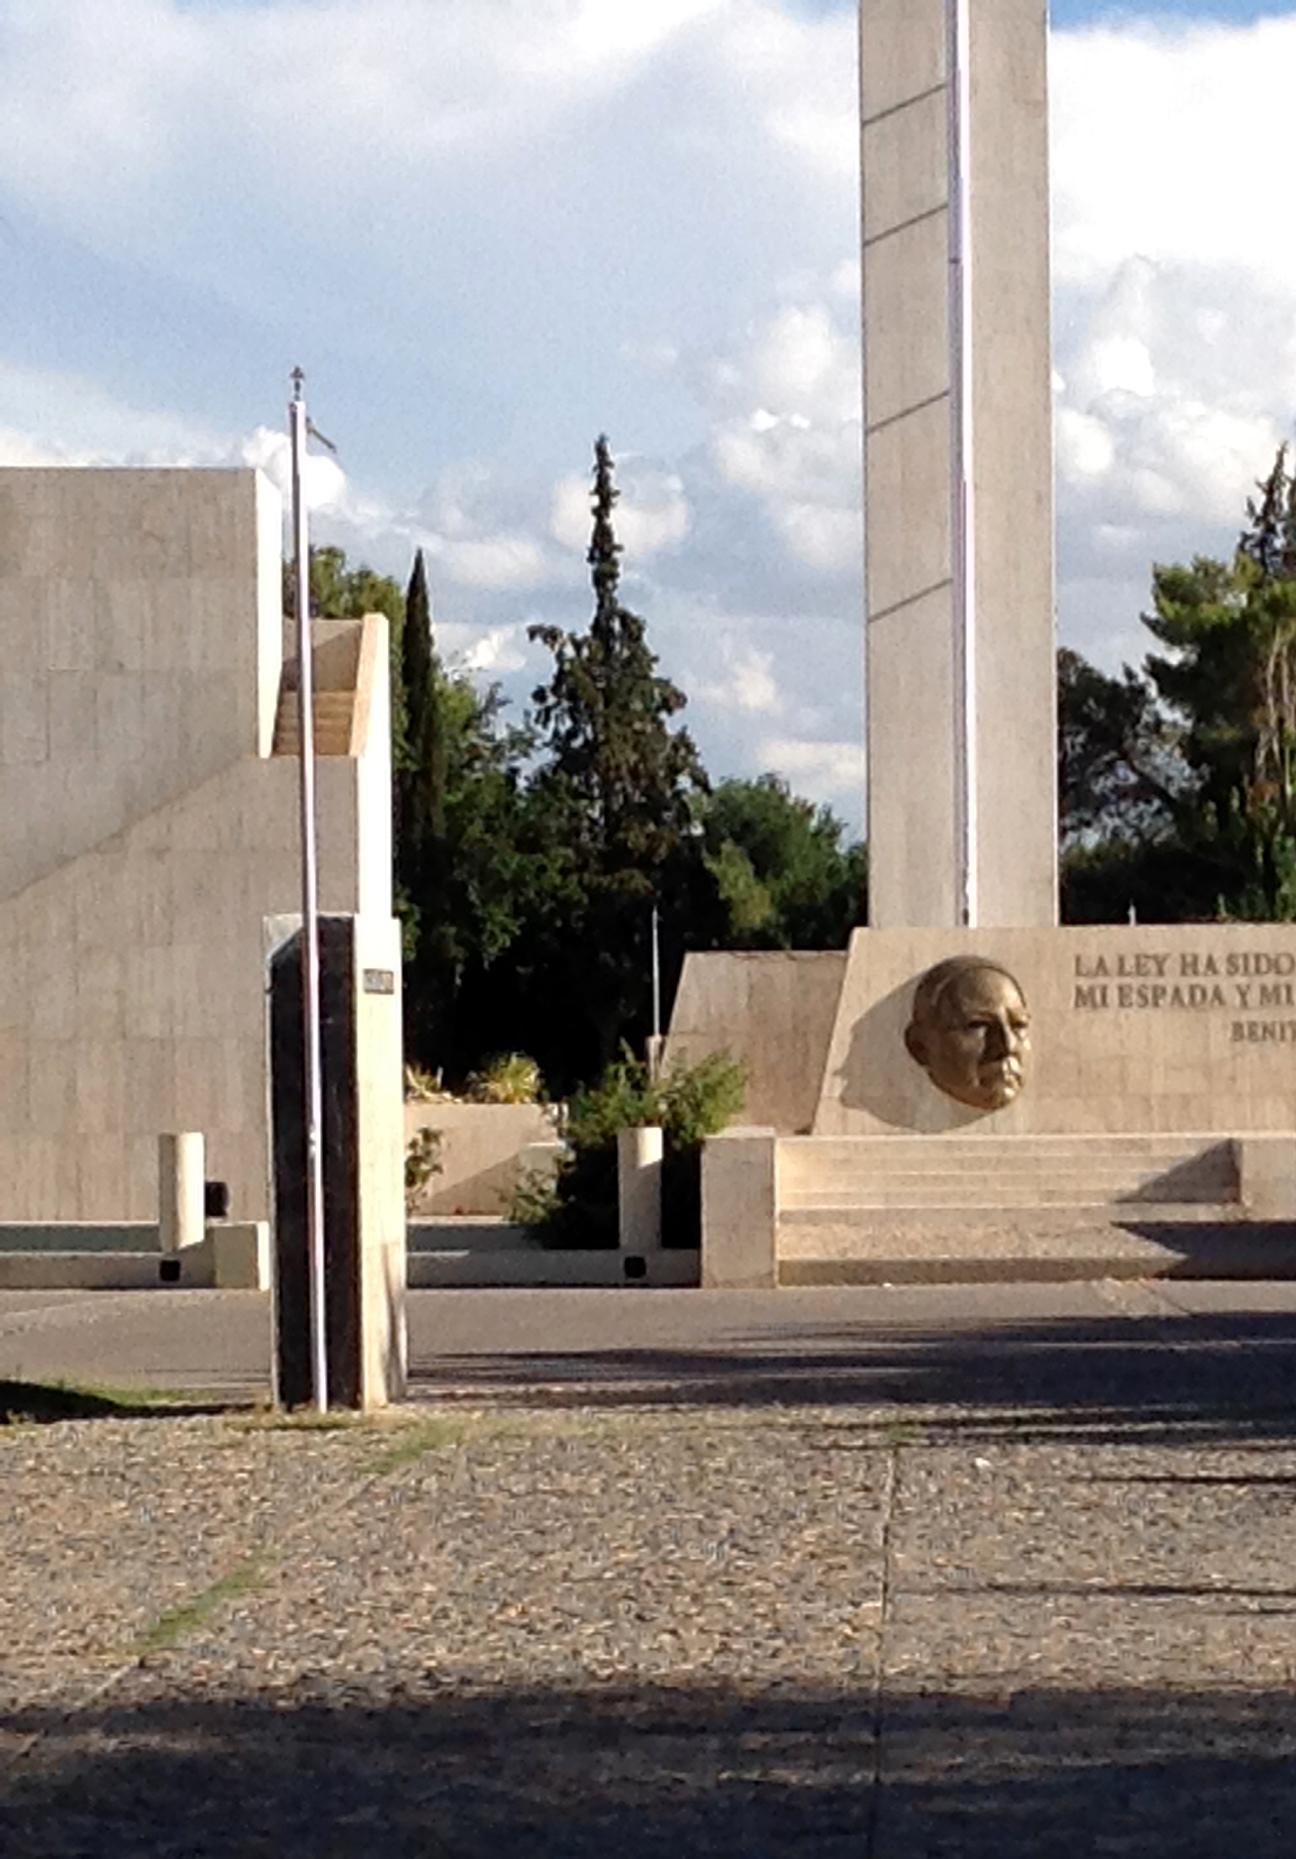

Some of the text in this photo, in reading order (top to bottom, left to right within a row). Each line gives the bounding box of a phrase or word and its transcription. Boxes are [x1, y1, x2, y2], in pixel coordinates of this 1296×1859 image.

[1074, 954, 1109, 977] LA
[1117, 953, 1171, 977] LEY
[1179, 953, 1219, 977] HA
[1226, 952, 1296, 976] SIDO
[1074, 984, 1109, 1008] MI
[1117, 983, 1226, 1008] ESPADA
[1235, 983, 1250, 1008] Y
[1259, 983, 1295, 1007] MI
